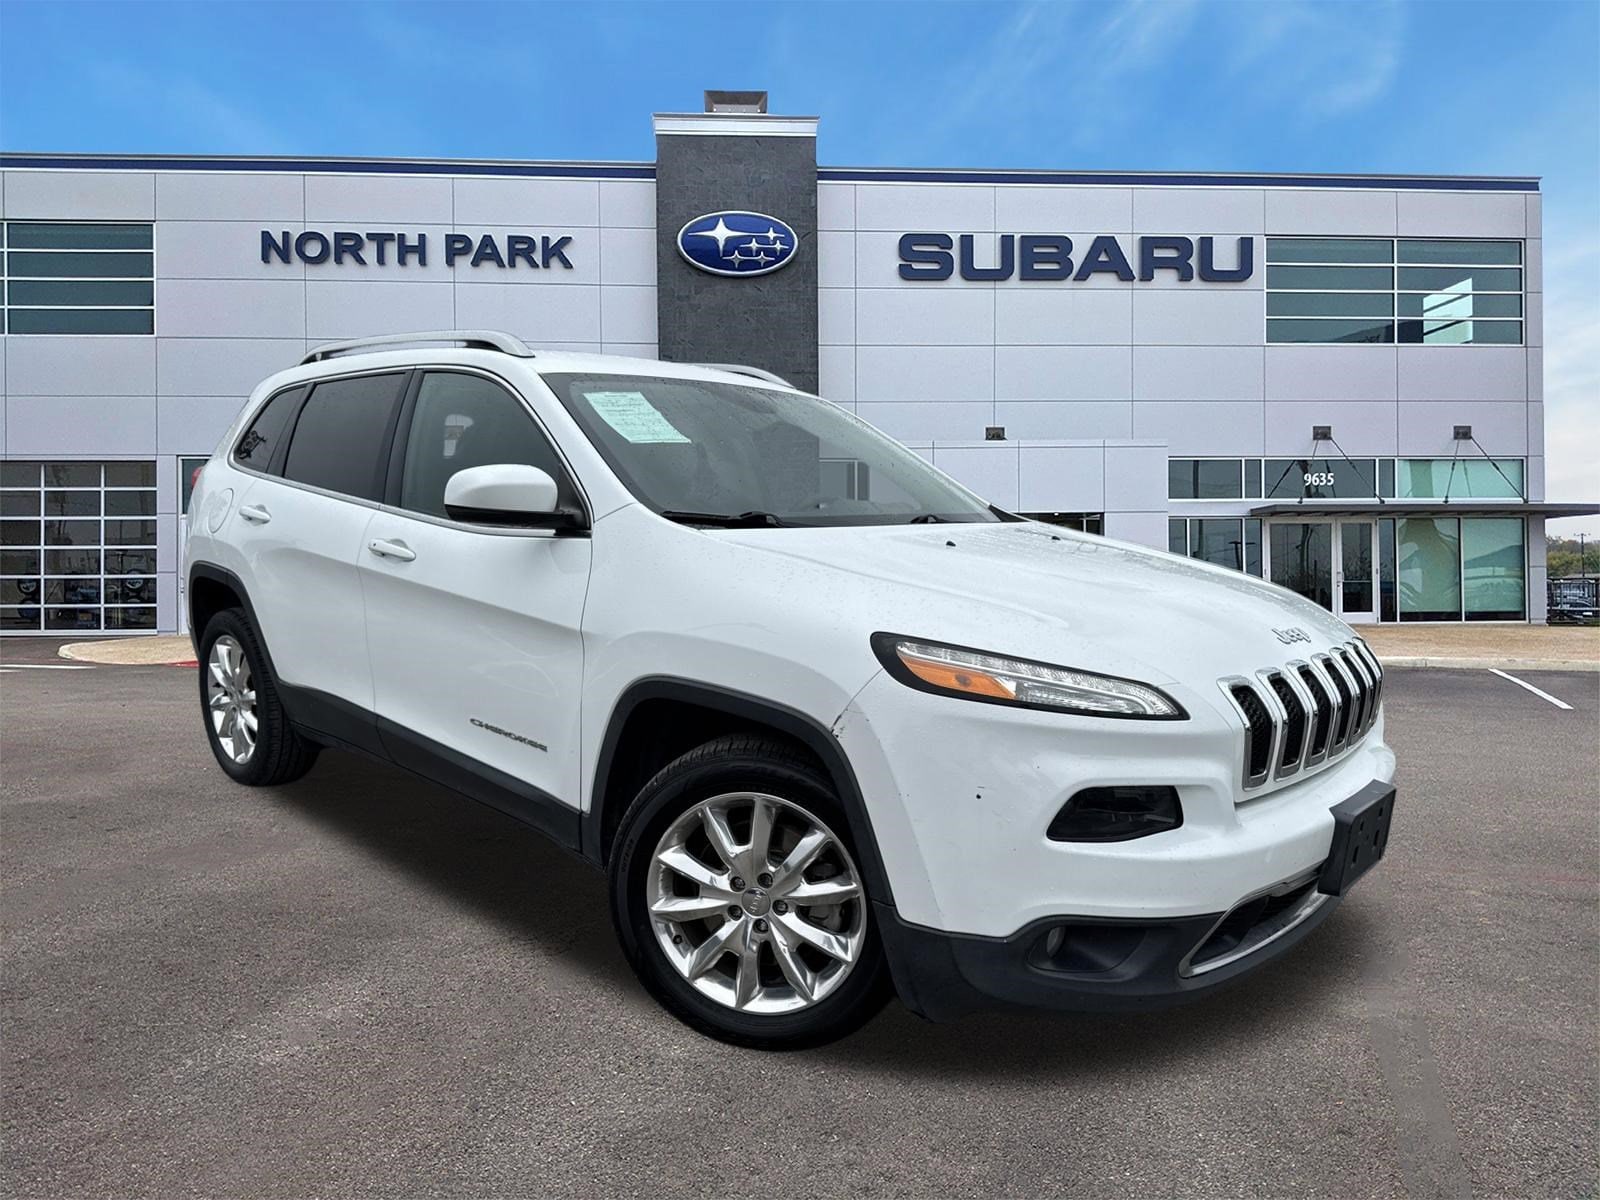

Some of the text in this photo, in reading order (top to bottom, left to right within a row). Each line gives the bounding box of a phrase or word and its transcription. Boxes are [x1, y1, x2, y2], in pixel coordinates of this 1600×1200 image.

[260, 229, 574, 270] NORTH PARK
[897, 233, 1254, 283] SUBARU
[1303, 472, 1335, 487] 9635
[1271, 626, 1312, 645] Jeep
